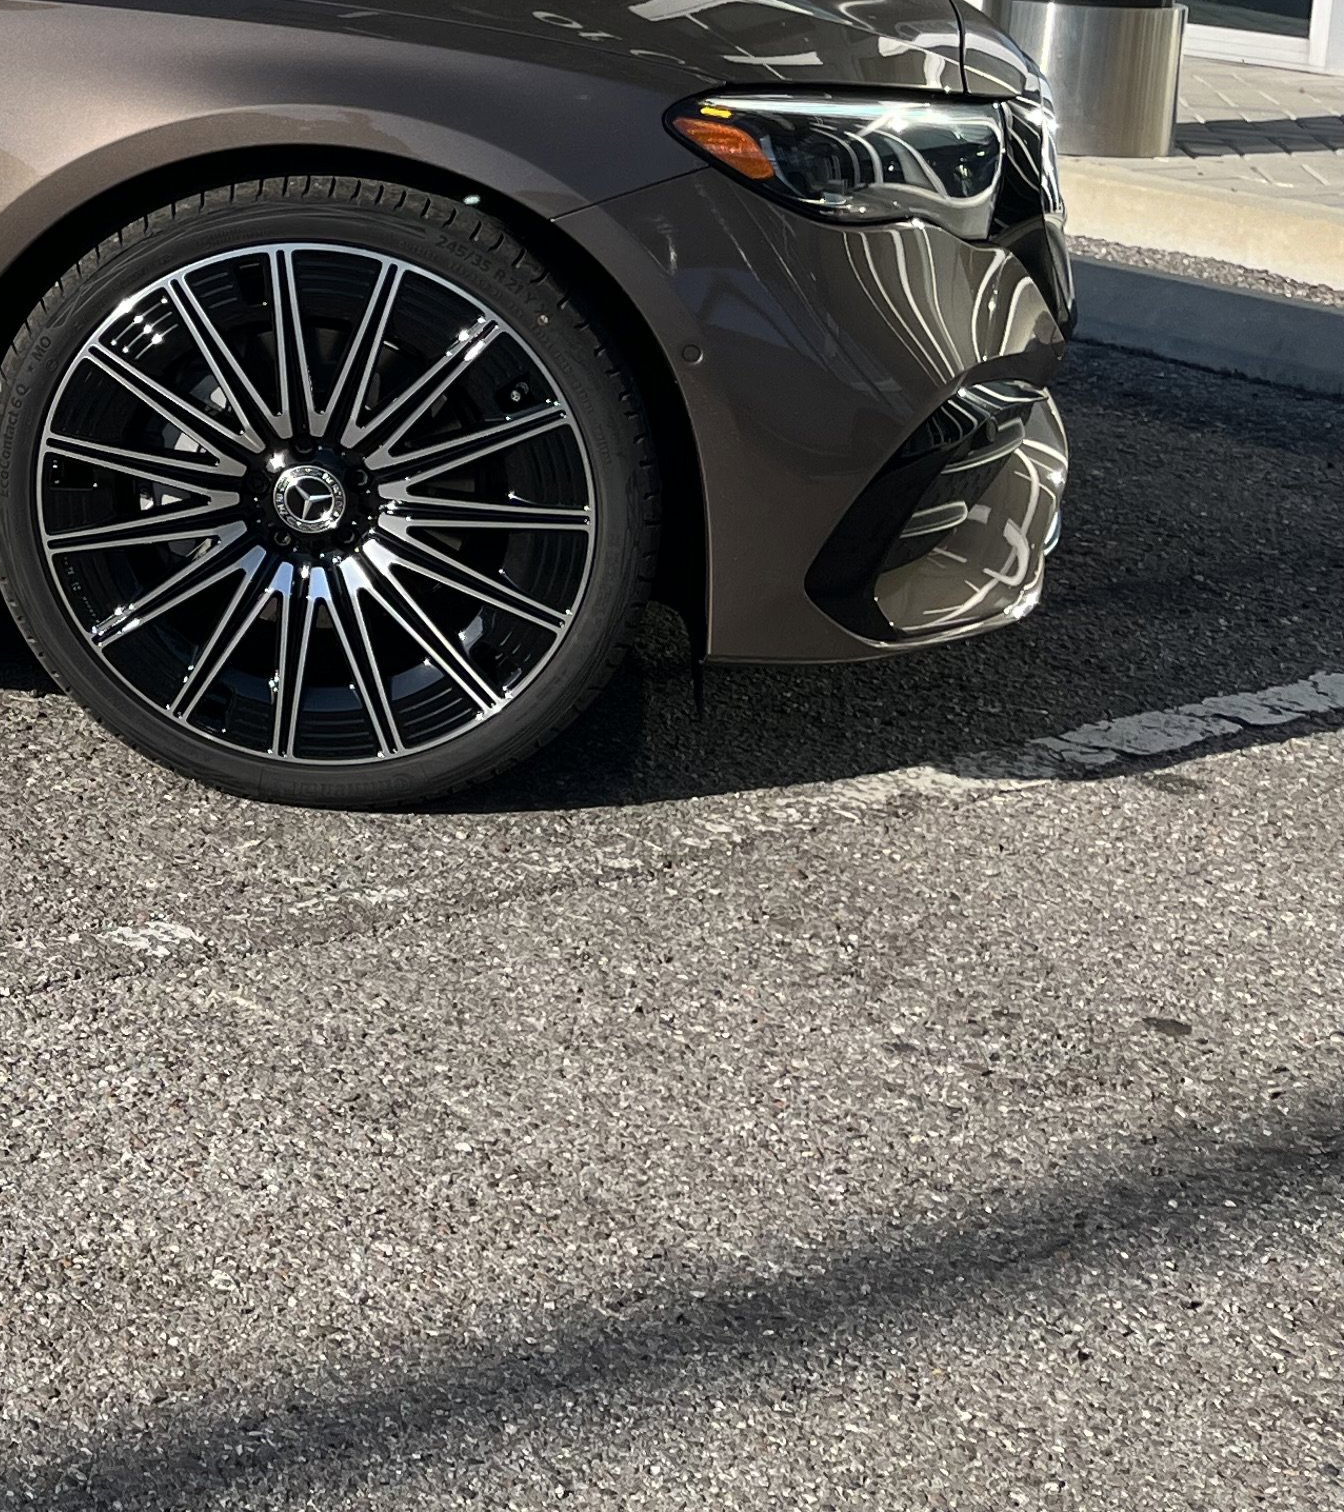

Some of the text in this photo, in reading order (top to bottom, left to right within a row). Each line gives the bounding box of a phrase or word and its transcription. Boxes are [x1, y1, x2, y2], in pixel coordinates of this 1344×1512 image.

[436, 236, 492, 272] 245/35
[15, 383, 30, 396] Q
[31, 335, 51, 362] MO
